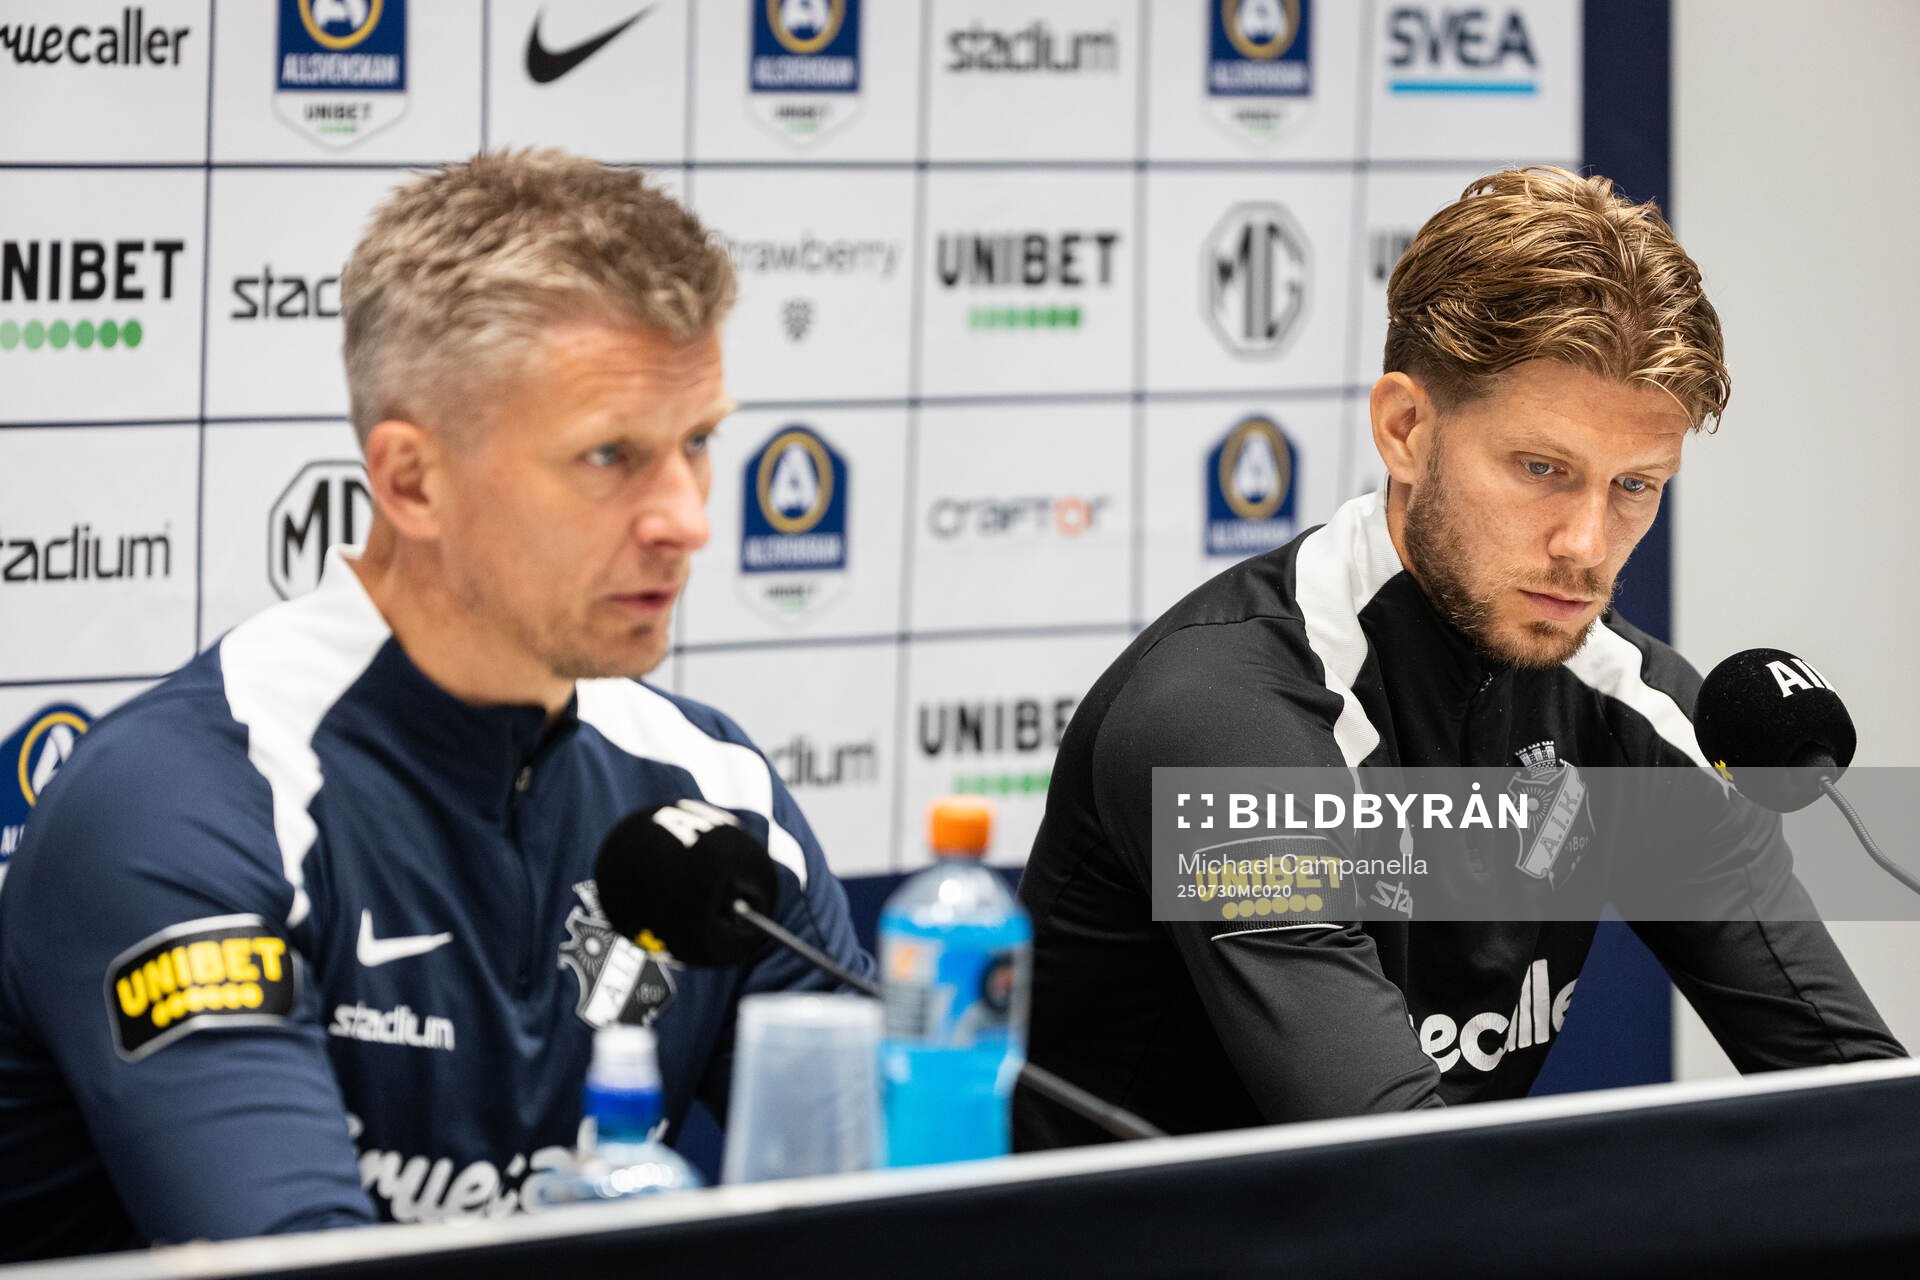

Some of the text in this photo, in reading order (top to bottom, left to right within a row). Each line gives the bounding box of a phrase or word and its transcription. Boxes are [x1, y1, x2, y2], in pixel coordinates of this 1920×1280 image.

[1389, 7, 1537, 67] SVEA
[0, 240, 186, 302] NIBET
[936, 232, 1120, 288] UNIBET
[0, 524, 172, 582] adium
[919, 697, 1075, 756] UNIBE
[116, 936, 286, 1018] UNIBET
[329, 1002, 455, 1052] stadium
